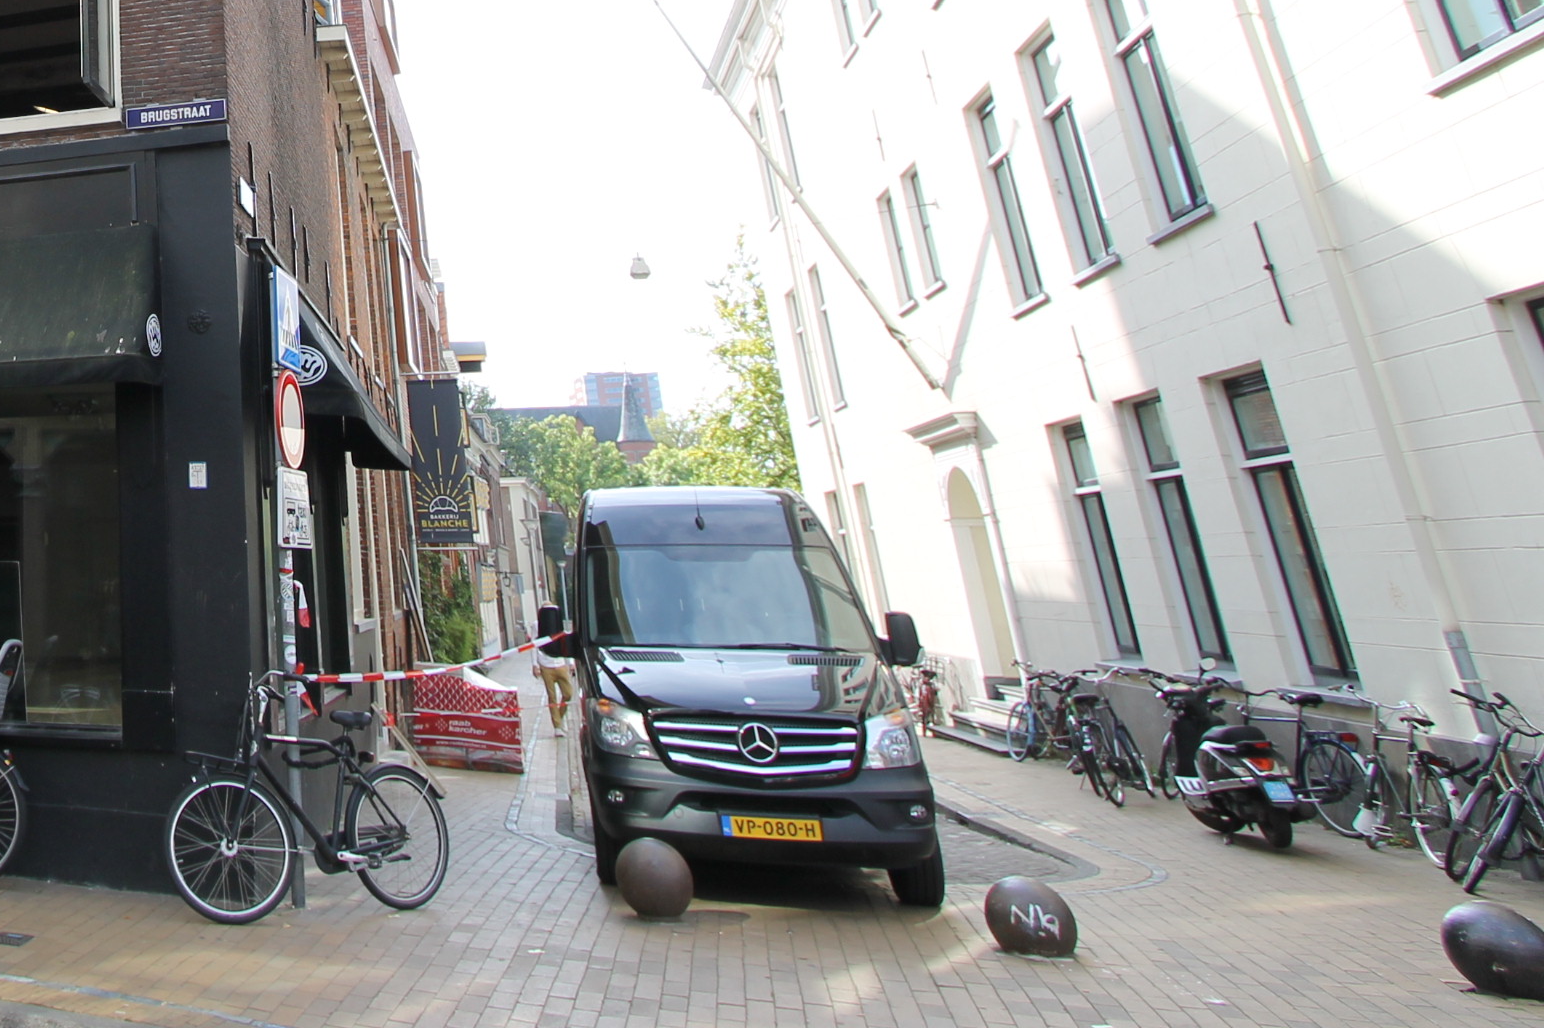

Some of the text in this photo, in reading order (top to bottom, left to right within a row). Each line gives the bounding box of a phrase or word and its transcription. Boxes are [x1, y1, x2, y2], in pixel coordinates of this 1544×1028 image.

[140, 105, 212, 123] BRUGSTRAAT
[421, 519, 469, 528] BLANCHE
[448, 726, 487, 736] karcher
[734, 818, 817, 838] VP-080-H
